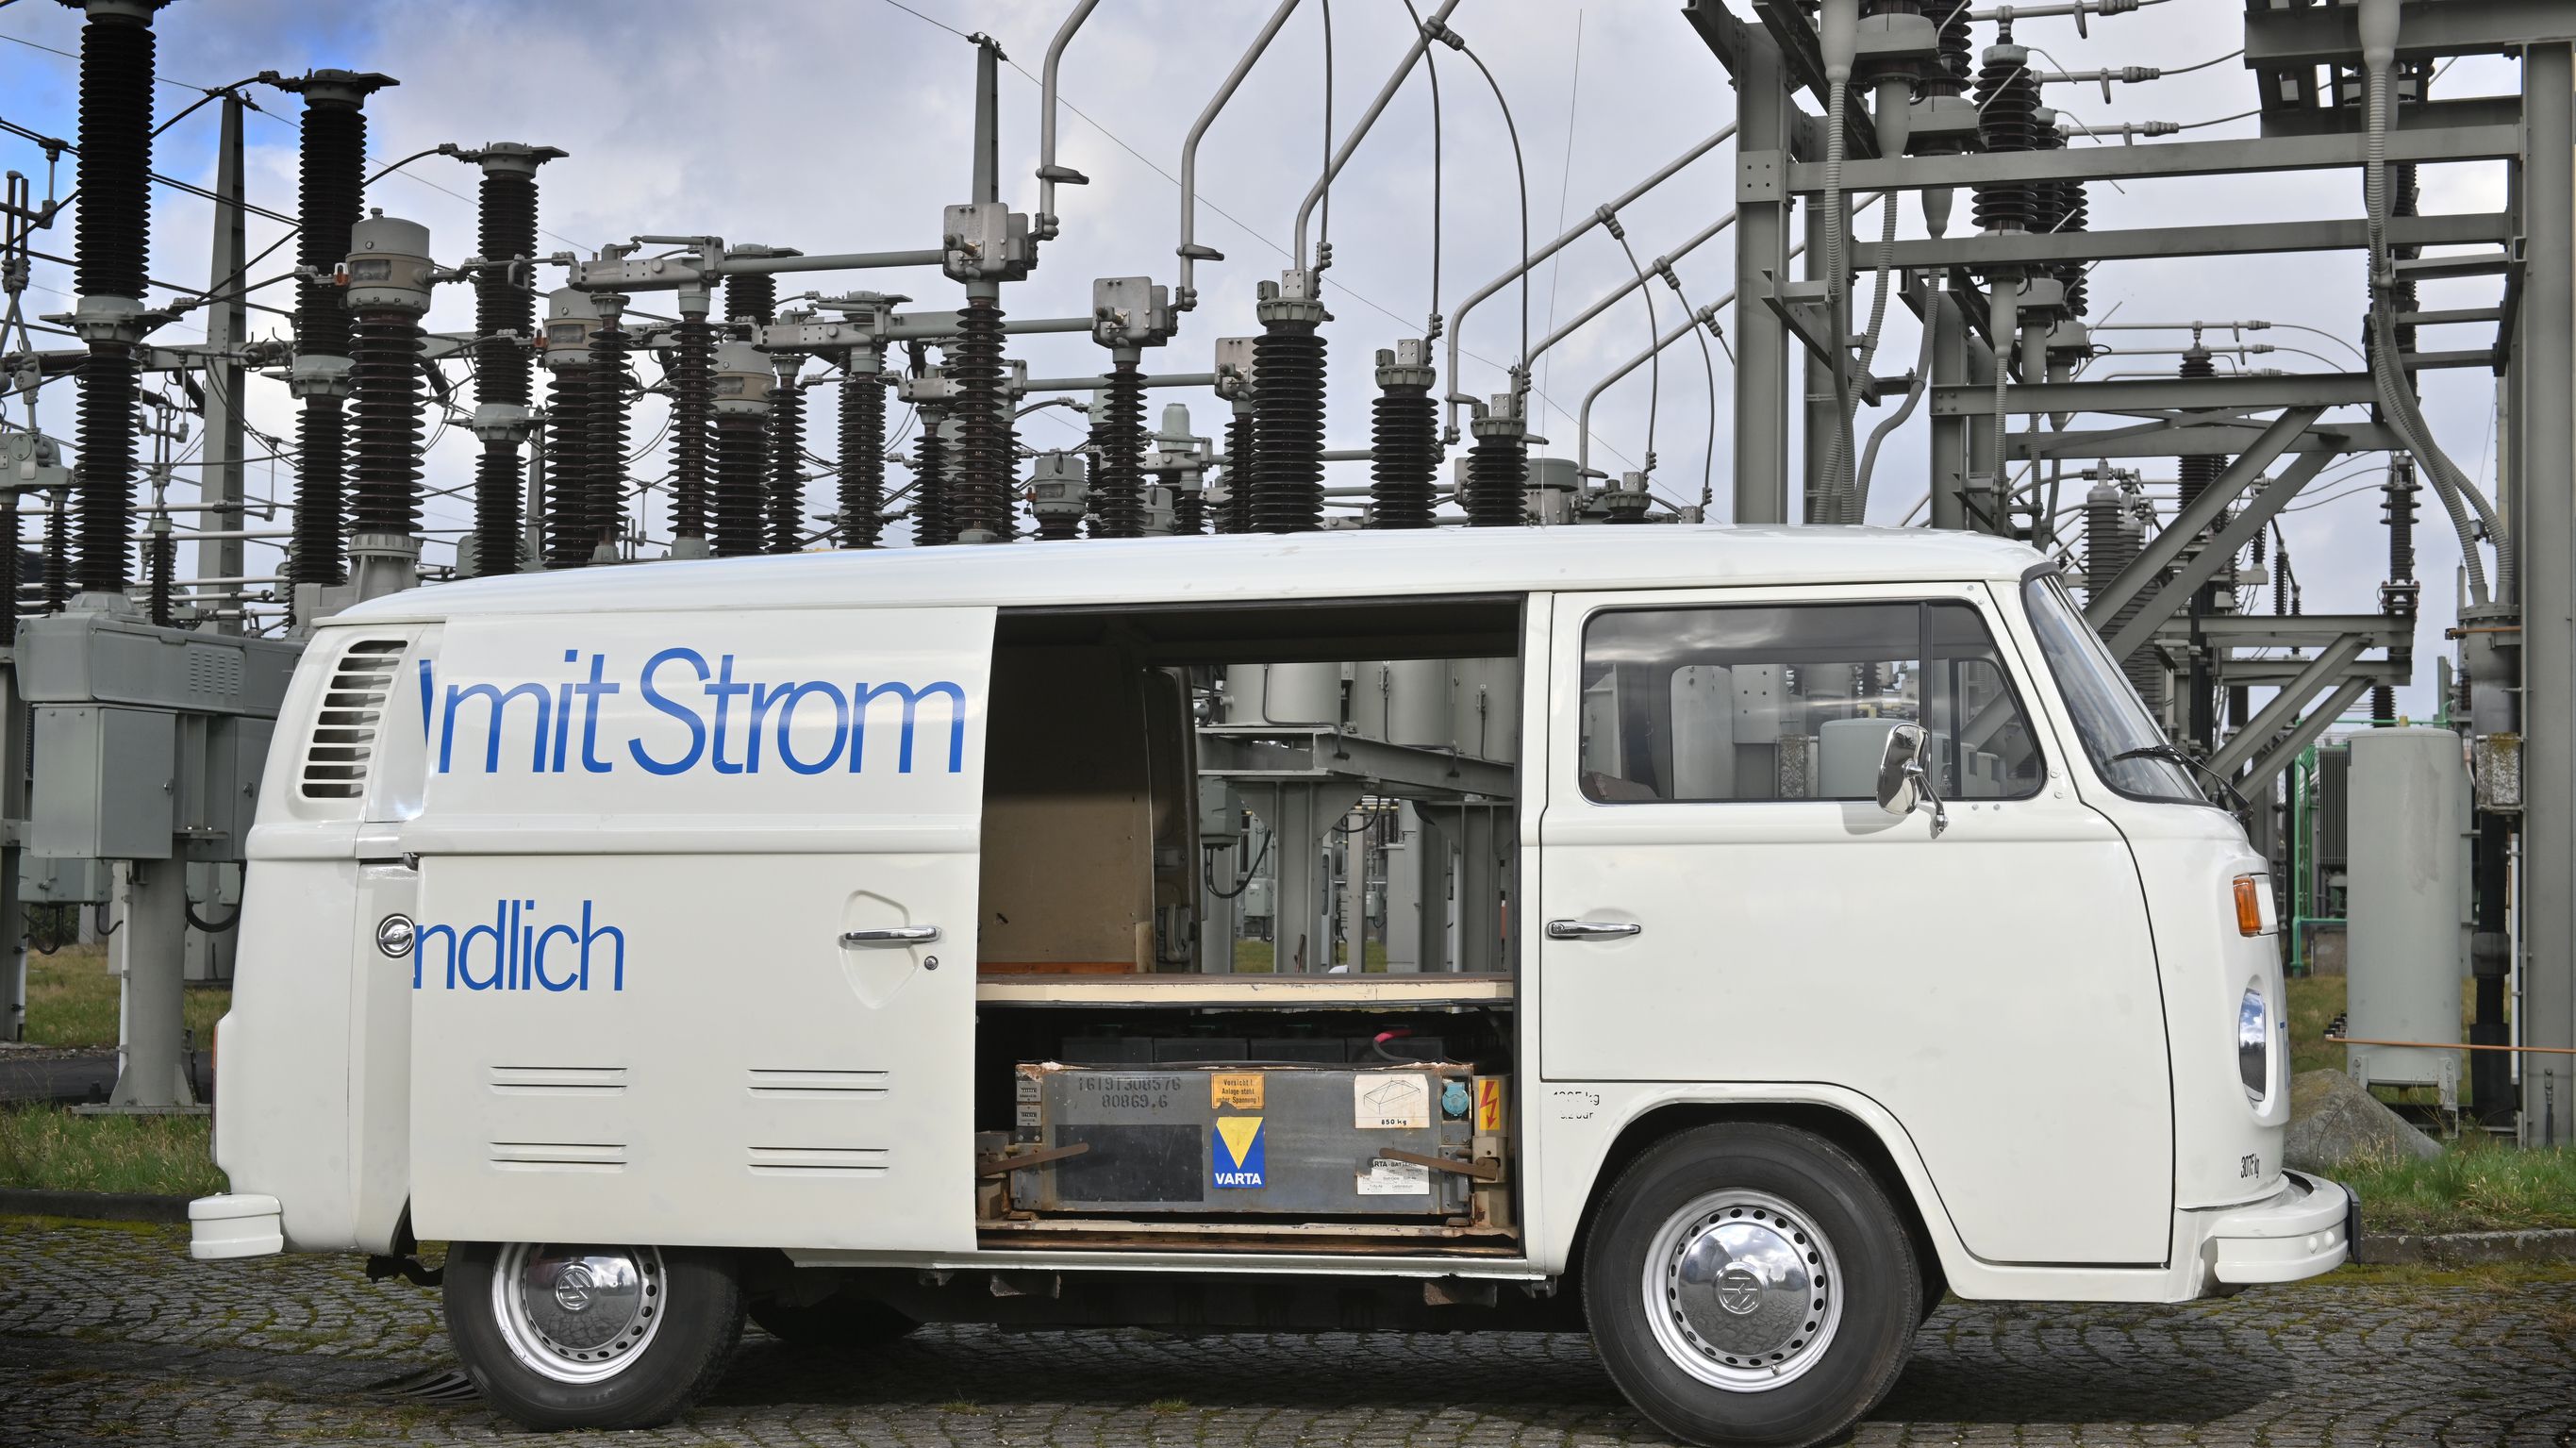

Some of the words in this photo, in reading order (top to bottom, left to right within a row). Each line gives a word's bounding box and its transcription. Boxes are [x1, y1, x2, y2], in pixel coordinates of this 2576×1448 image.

[438, 649, 621, 774] mit
[627, 647, 967, 775] Strom
[412, 899, 624, 992] ndlich
[1214, 1173, 1262, 1185] VARTA
